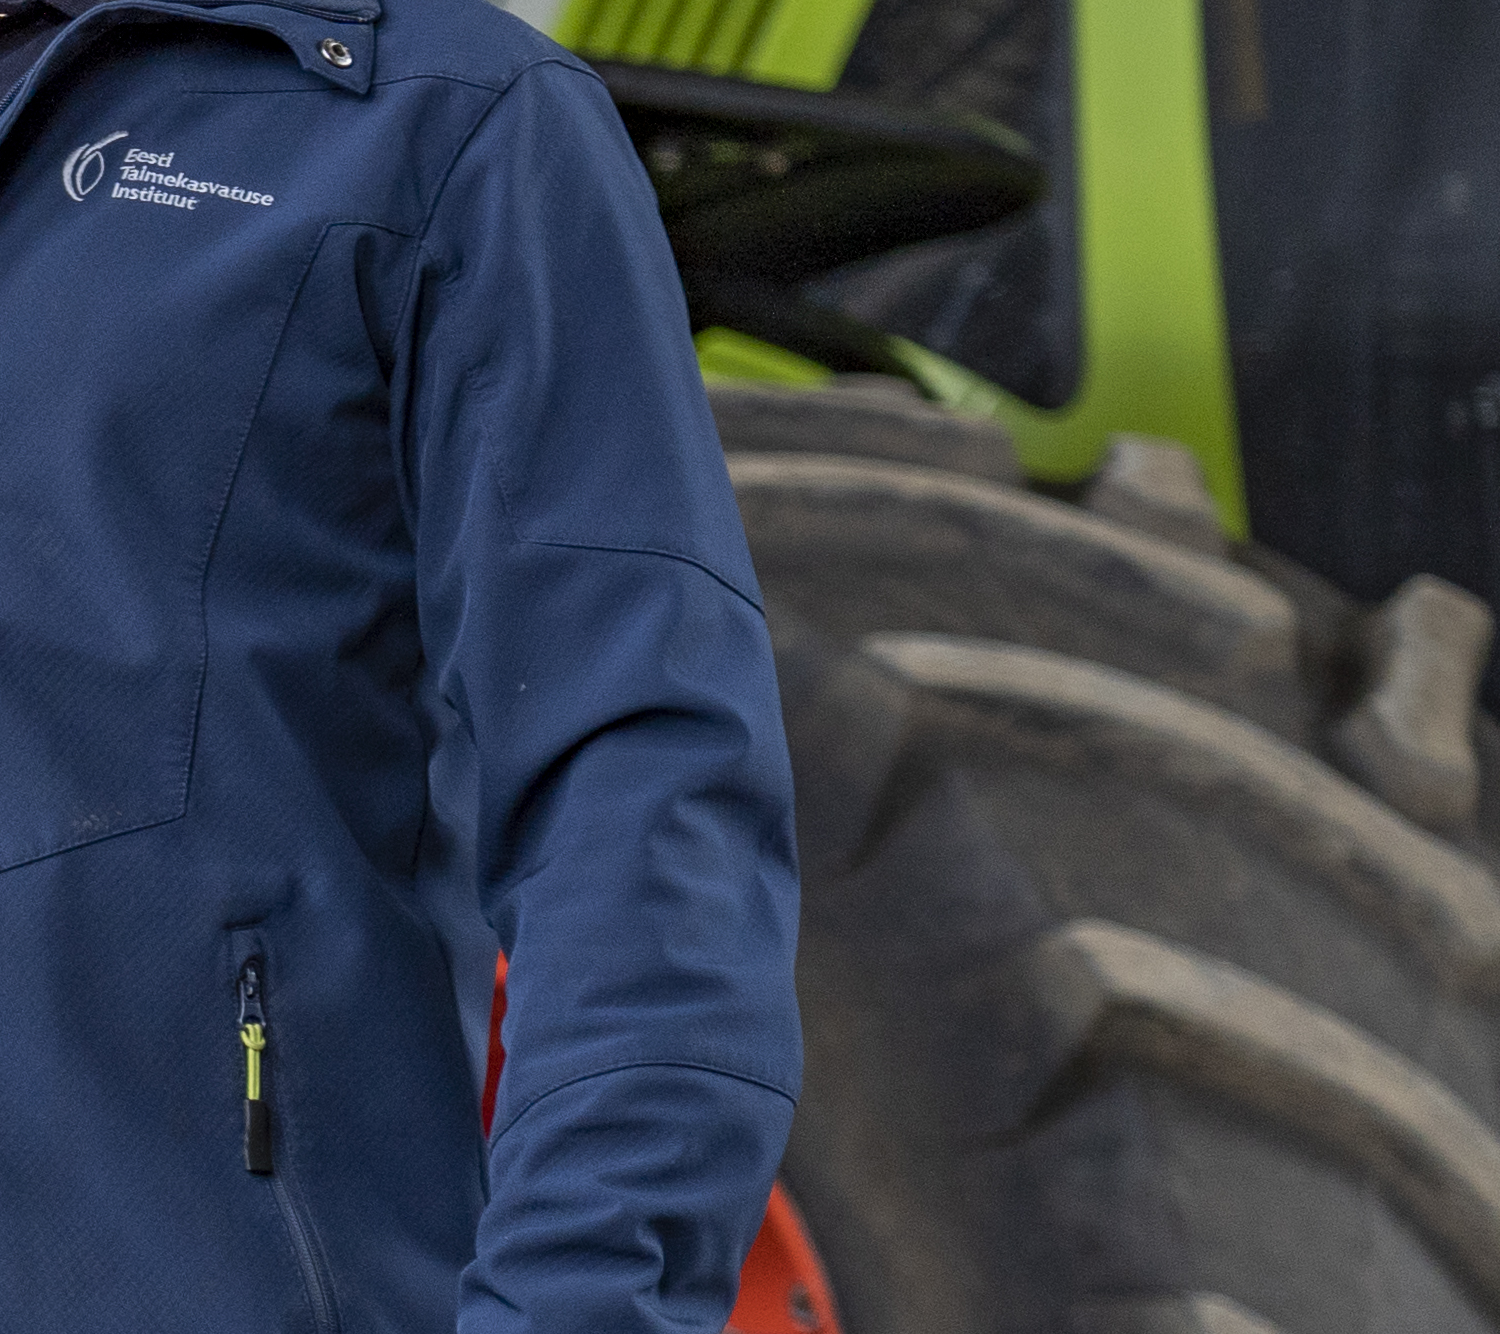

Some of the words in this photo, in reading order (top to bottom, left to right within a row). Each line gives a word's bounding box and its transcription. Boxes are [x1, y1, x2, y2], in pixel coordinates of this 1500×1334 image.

[124, 147, 175, 168] Eesti
[110, 182, 200, 211] Instituut
[119, 165, 275, 207] Taimekasvatuse
